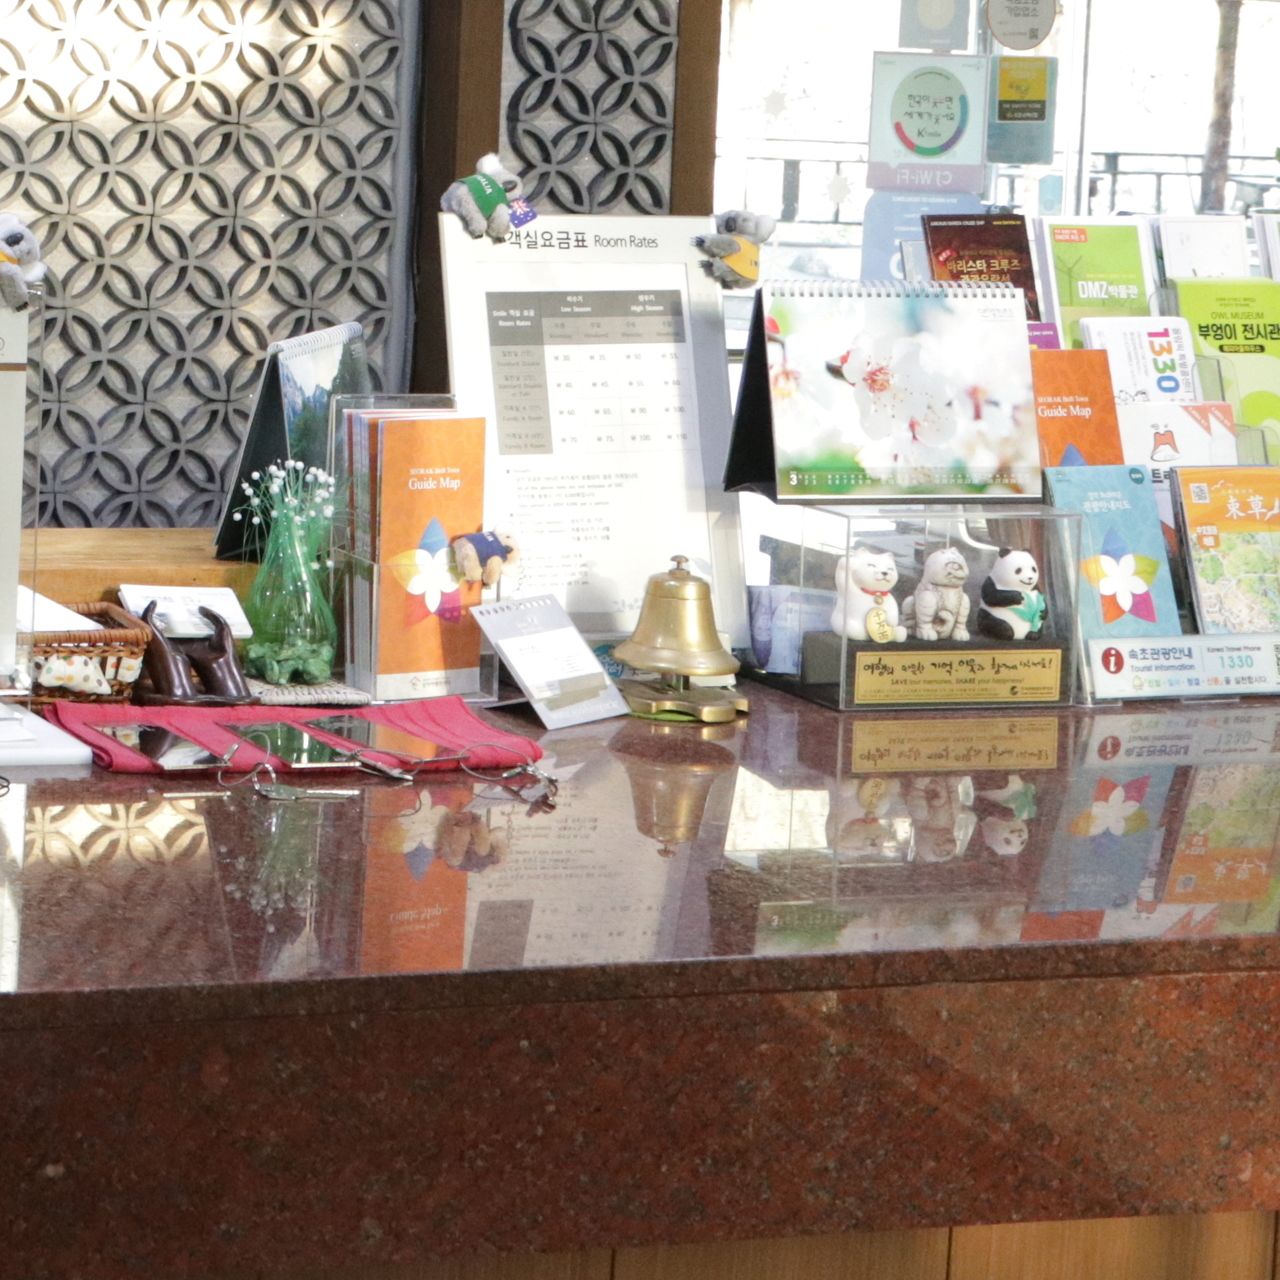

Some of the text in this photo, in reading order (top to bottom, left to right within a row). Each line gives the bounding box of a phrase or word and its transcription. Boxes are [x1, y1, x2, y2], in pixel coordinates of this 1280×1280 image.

[508, 231, 659, 250] 객실요금표 Room Rates
[947, 259, 1021, 274] 바리스타 크루즈
[1211, 311, 1264, 320] OWL MUSEUM
[1198, 323, 1238, 342] 부엉이
[1147, 327, 1181, 394] 1330
[1038, 405, 1092, 419] Guide Map
[408, 477, 461, 491] Guide Map
[789, 473, 798, 485] 3
[1128, 646, 1193, 661] 속초관광안내
[1130, 663, 1153, 672] Tourist
[1218, 654, 1254, 670] 1330
